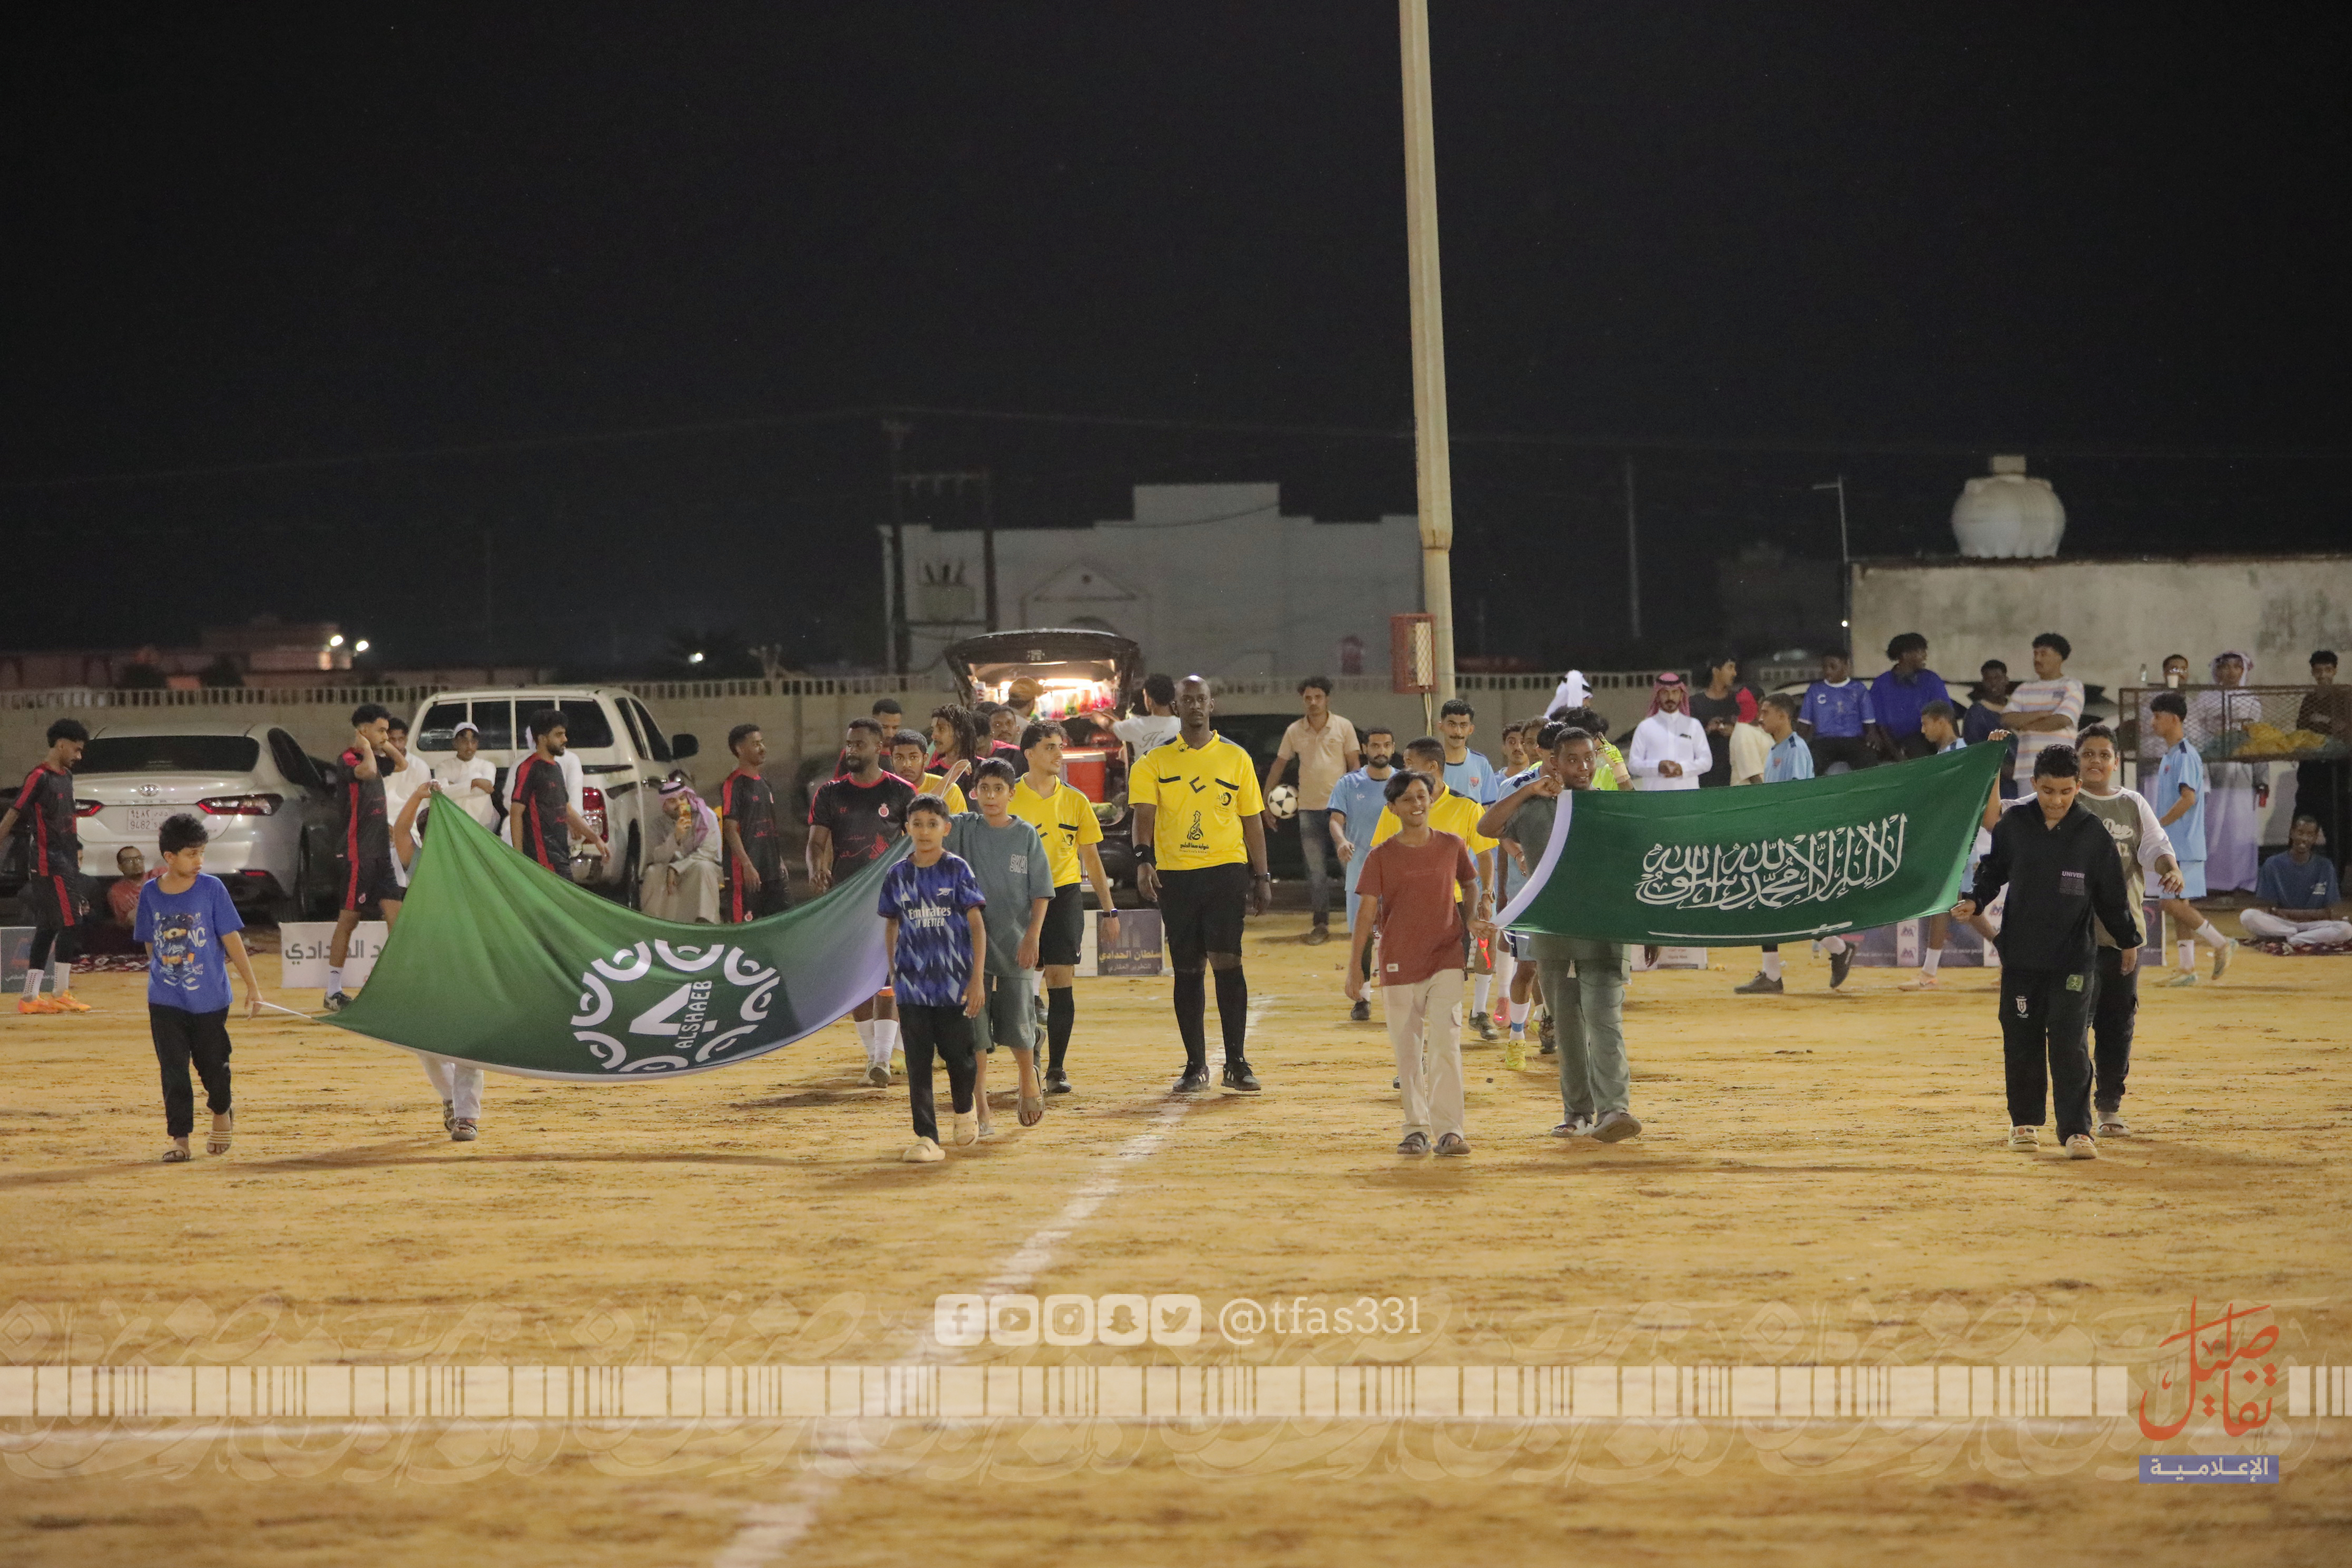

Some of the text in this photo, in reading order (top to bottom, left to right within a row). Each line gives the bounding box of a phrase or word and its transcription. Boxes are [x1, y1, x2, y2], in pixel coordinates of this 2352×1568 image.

[130, 820, 151, 830] 9482
[908, 906, 951, 920] Emirates
[923, 917, 945, 927] BETTER
[675, 981, 712, 1048] ALSHAEB
